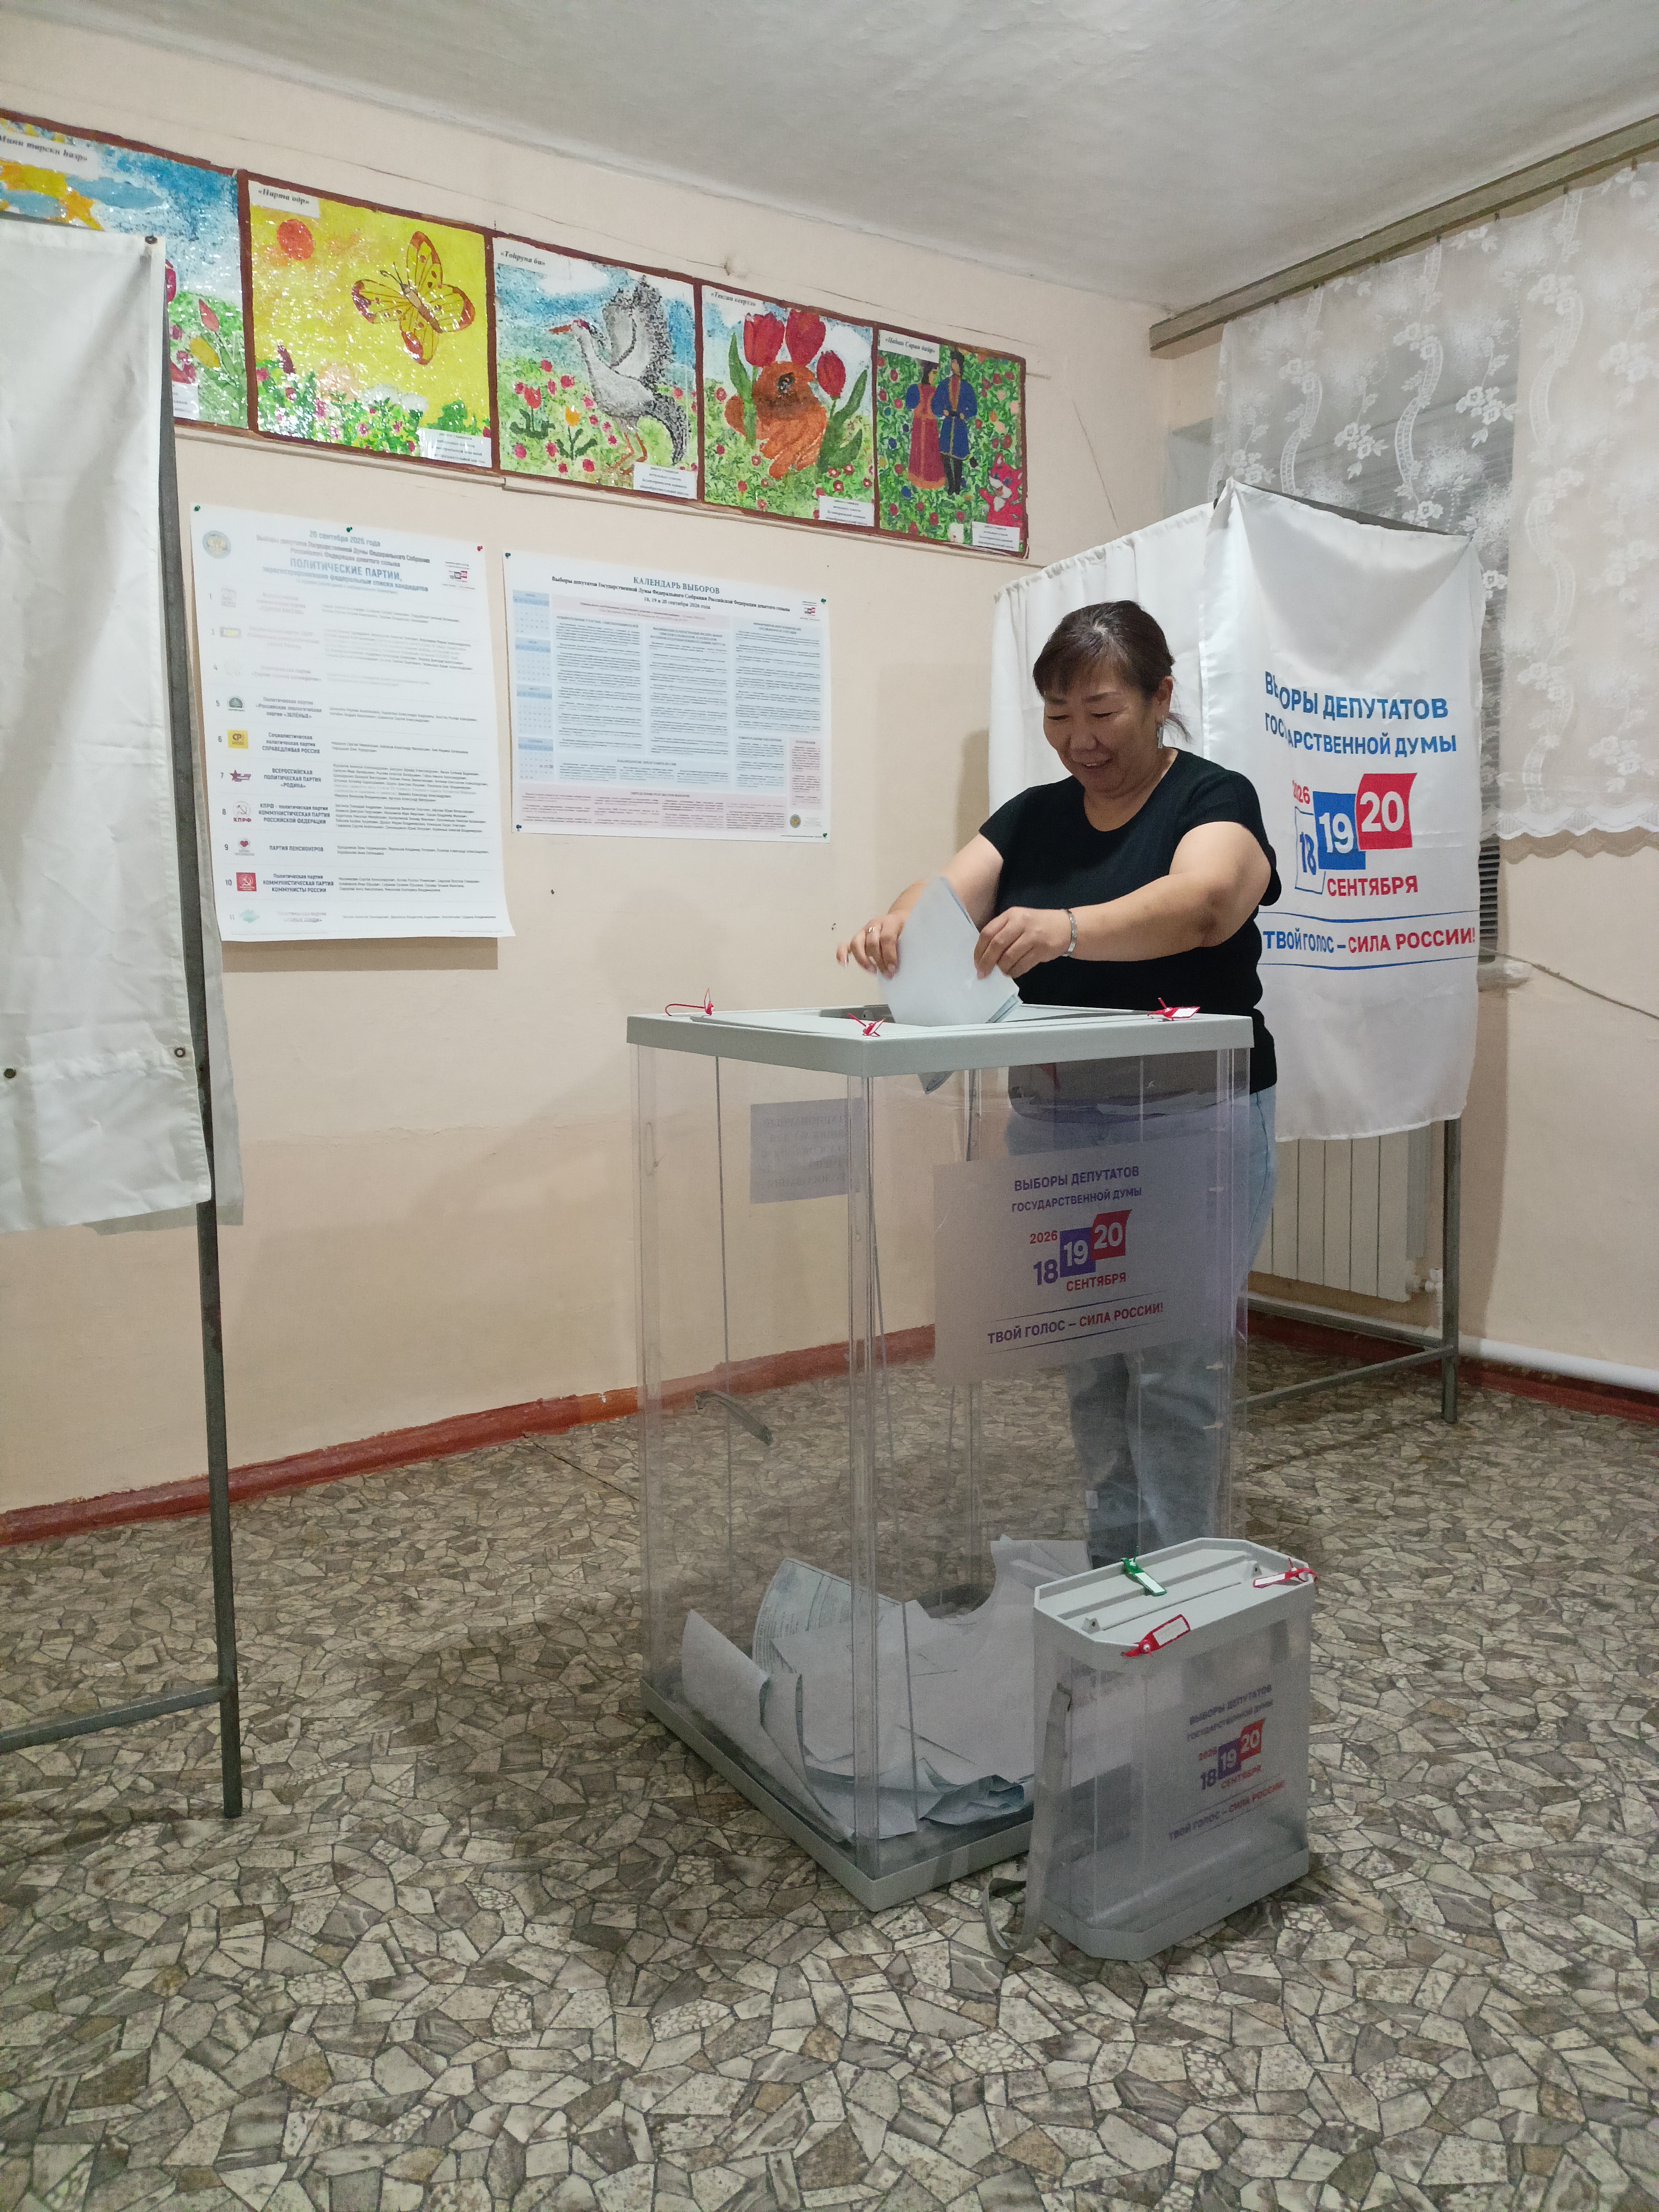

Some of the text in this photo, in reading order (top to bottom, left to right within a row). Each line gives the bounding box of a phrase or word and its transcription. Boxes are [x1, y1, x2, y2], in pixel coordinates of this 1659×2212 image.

[350, 536, 365, 544] 2026
[290, 558, 402, 582] ПОЛИТИЧЕСКИЕ ПАРТИИ,
[633, 576, 720, 594] КАЛЕНДАРЬ ВЫБОРОВ
[1265, 671, 1449, 721] ВОРЫ ДЕПУТАТОВ
[1394, 735, 1457, 757] ДУМЫ
[1300, 791, 1405, 875] 18 19 20
[1327, 875, 1418, 897] СЕНТЯБРЯ
[1263, 928, 1302, 950] ТВОЙ
[1303, 934, 1334, 953] ГОЛОС
[1348, 935, 1391, 953] СИЛА
[1395, 927, 1476, 950] РОССИИ!
[1015, 1166, 1139, 1192] ВЫБОРЫ ДЕПУТАТОВ
[1012, 1187, 1142, 1213] ГОСУДАРСТВЕННОЙ ДУМЫ
[1029, 1230, 1058, 1244] 2026
[1033, 1222, 1123, 1286] 18 19 20
[1066, 1272, 1126, 1292] СЕНТЯБРЯ
[987, 1325, 1021, 1344] ТВОЙ
[1025, 1320, 1066, 1338] ГОЛОС
[1079, 1311, 1111, 1328] СИЛА
[1114, 1302, 1163, 1321] РОССИИ!
[1200, 1730, 1261, 1790] 18 19 20
